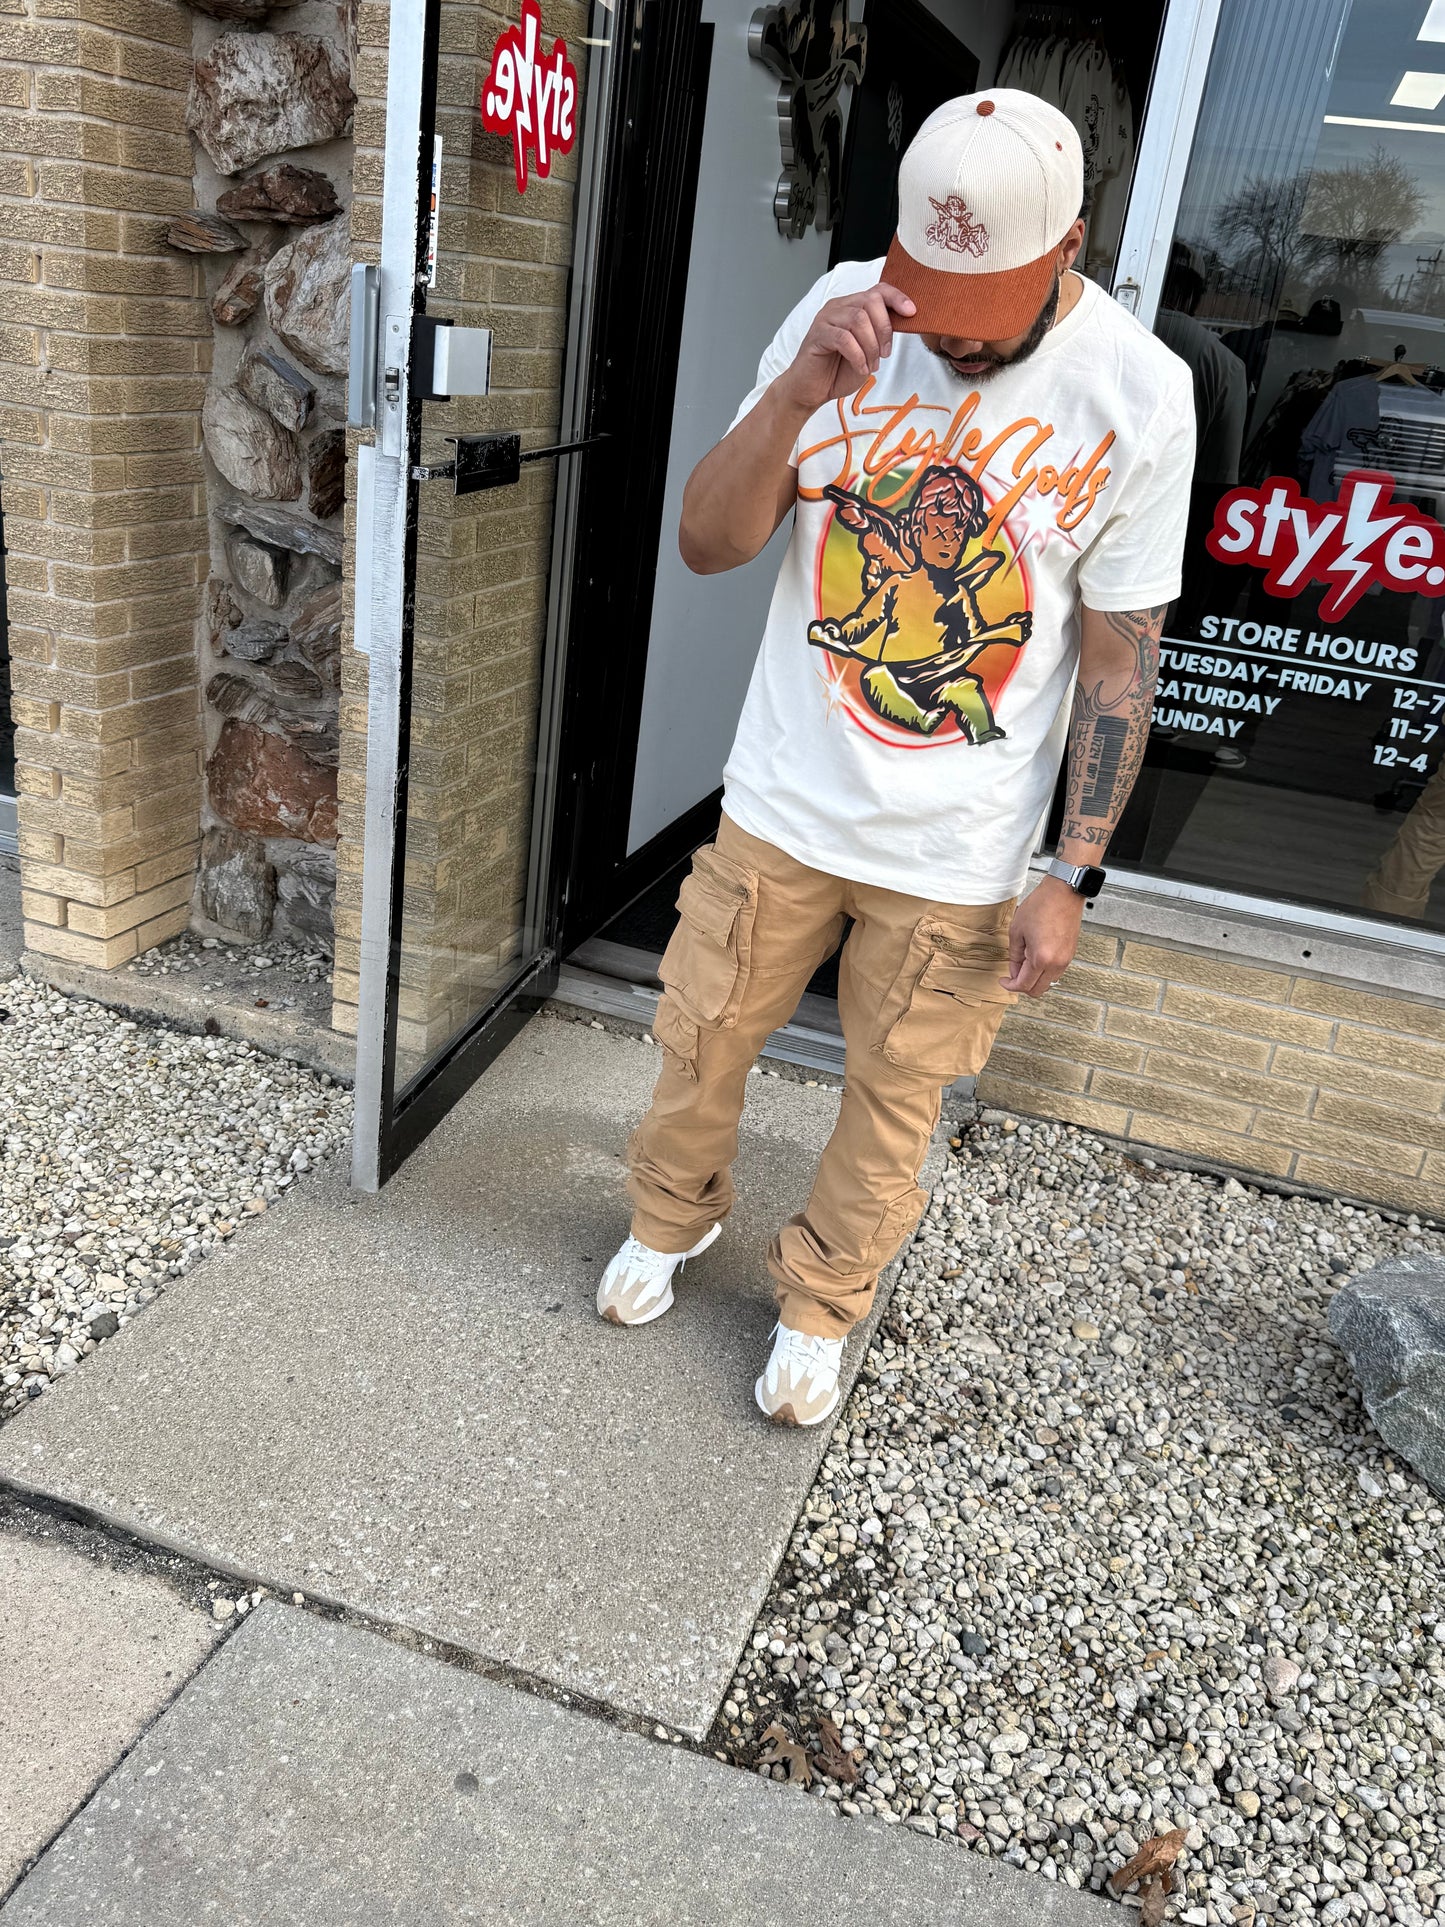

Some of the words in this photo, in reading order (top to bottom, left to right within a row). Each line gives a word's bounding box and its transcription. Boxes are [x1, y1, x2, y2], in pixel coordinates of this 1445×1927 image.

[797, 375, 983, 508] Style
[968, 416, 1117, 551] Gods
[1200, 615, 1301, 653] STORE
[1305, 631, 1419, 672] HOURS
[1155, 677, 1282, 715] SATURDAY
[1389, 717, 1440, 744] 11-7
[1159, 648, 1372, 701] TUESDAY-FRIDAY
[1392, 687, 1445, 715] 12-7
[1372, 744, 1429, 773] 12-4
